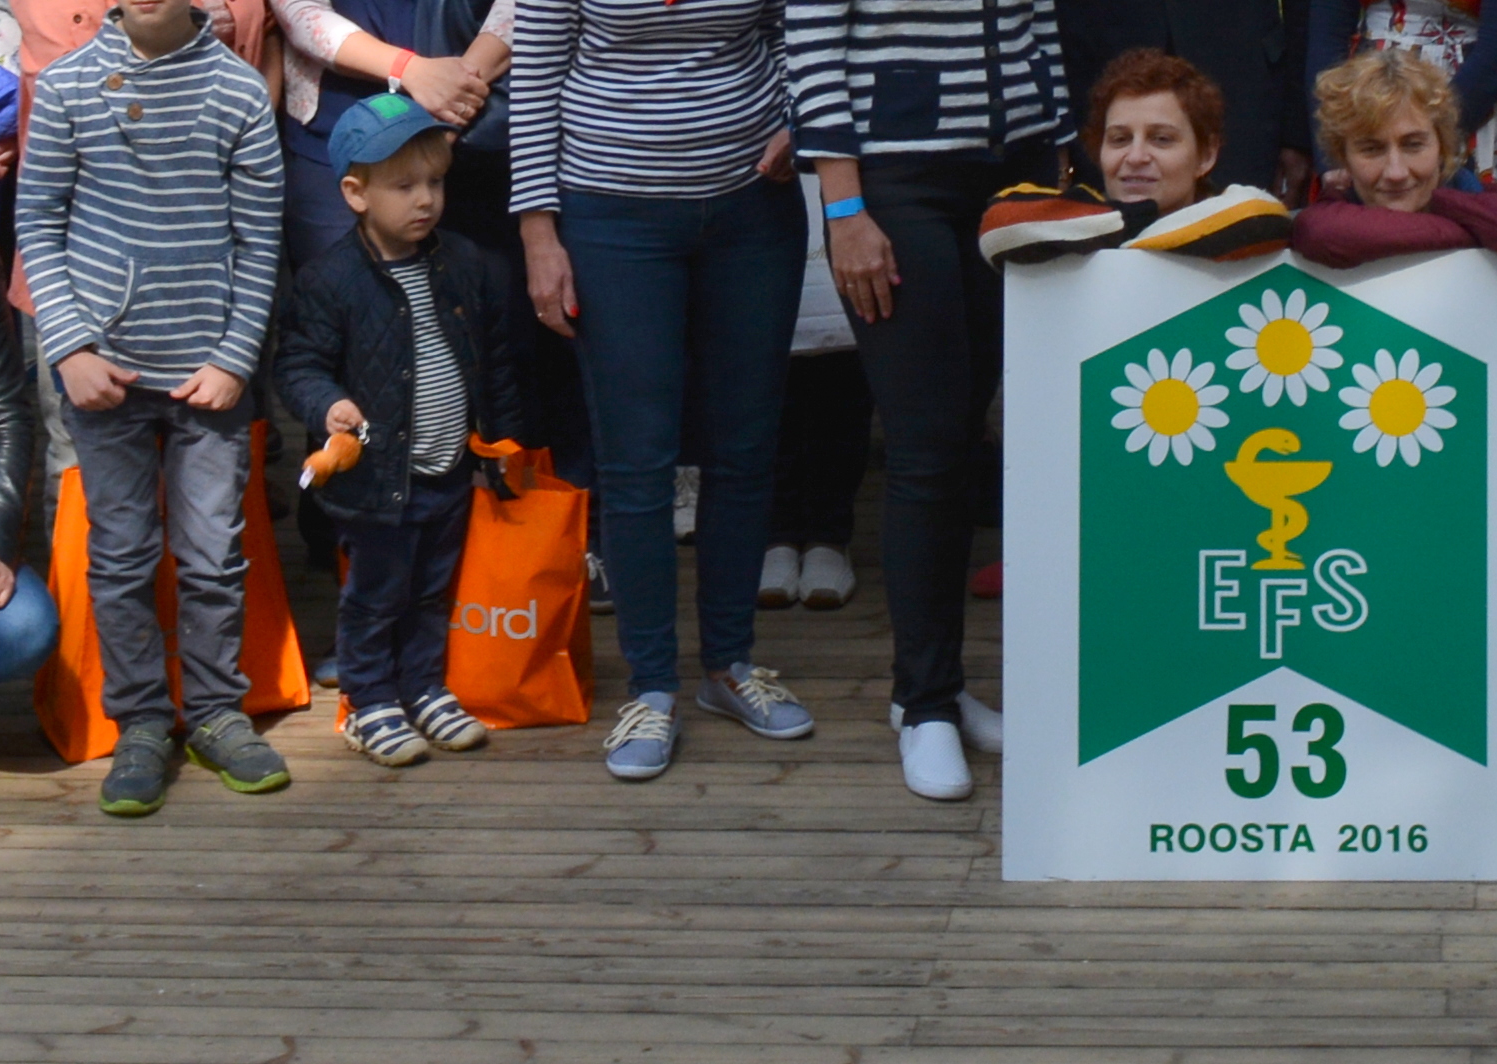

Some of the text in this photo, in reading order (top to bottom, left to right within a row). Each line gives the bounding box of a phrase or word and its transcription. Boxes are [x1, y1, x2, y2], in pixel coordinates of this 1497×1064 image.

[1197, 547, 1370, 660] EFS
[1223, 702, 1348, 800] 53
[1149, 822, 1429, 855] ROOSTA 2016
